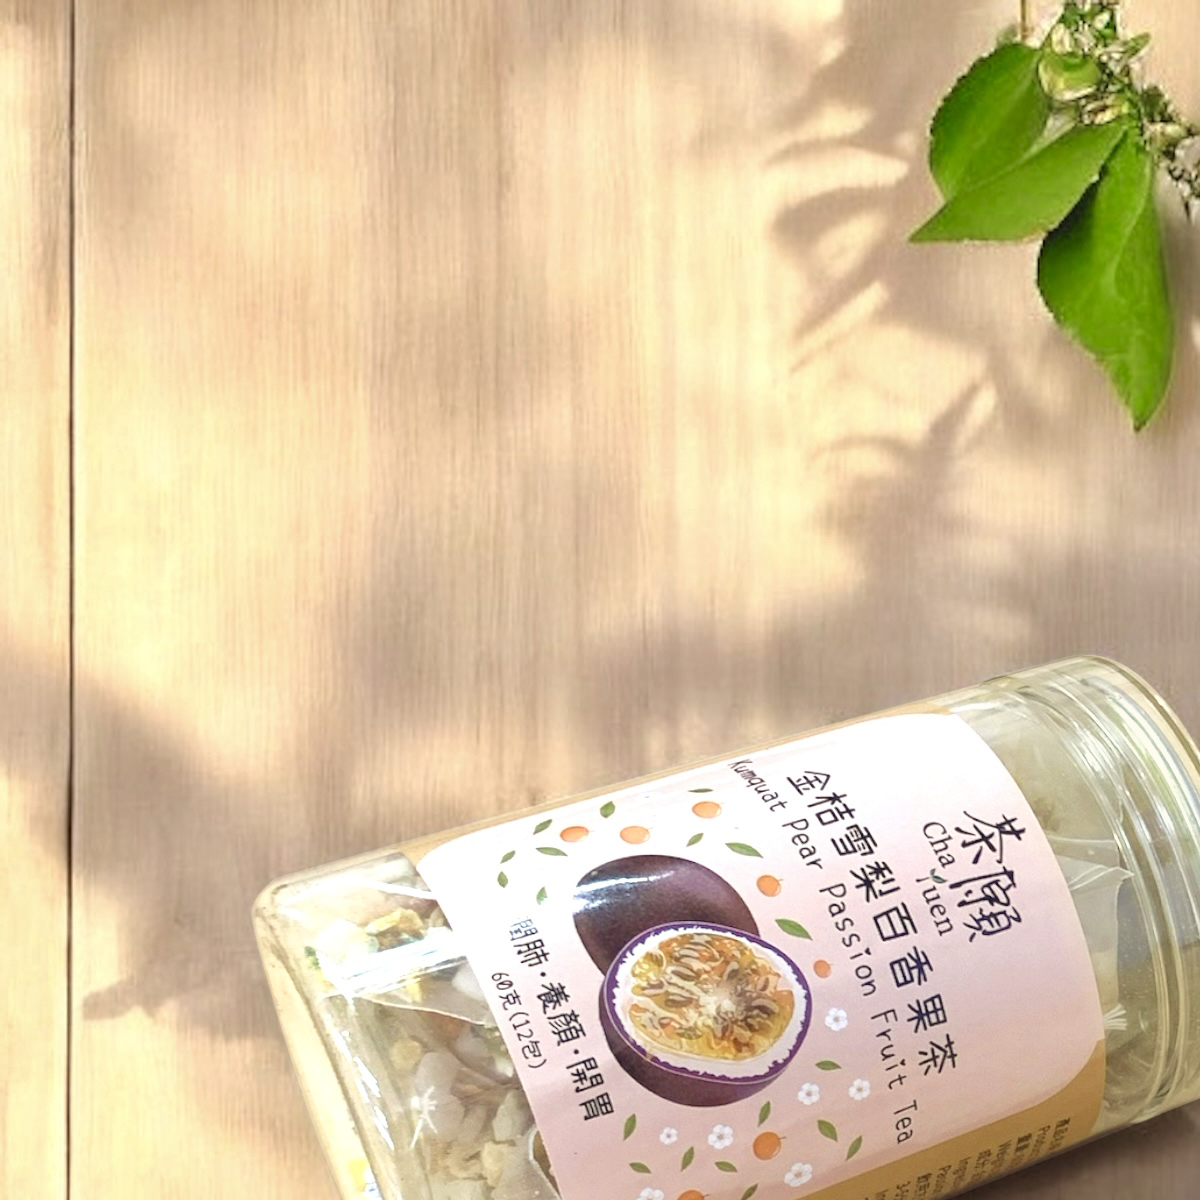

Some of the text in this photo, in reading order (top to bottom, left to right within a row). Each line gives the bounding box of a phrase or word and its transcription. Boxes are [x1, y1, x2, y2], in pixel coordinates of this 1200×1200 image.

[728, 758, 918, 1145] Kumquat Pear Passion Fruit Tea
[787, 770, 957, 1076] 金桔雪梨百香果茶
[922, 821, 955, 868] Cha
[949, 811, 1026, 942] 茶願
